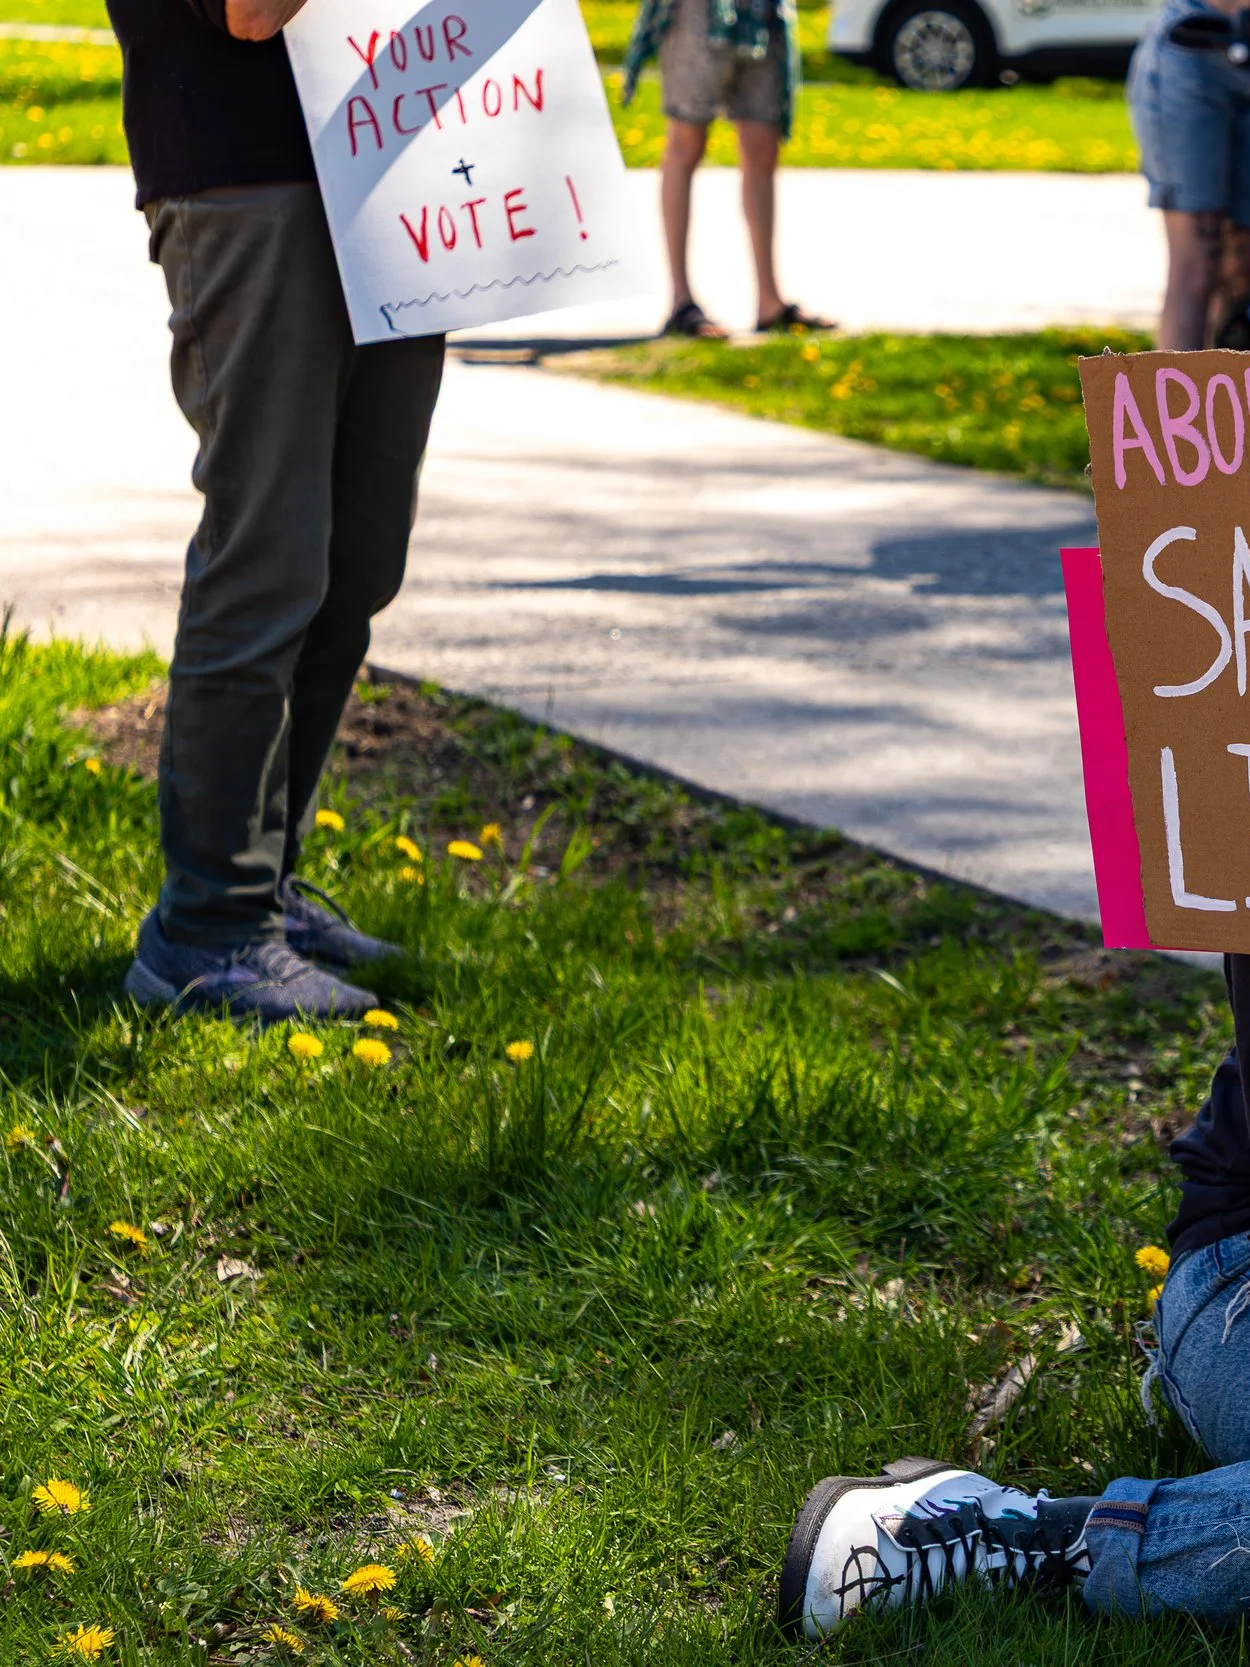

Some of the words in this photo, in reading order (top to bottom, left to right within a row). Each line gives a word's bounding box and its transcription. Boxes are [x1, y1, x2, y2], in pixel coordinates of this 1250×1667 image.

[348, 15, 473, 90] YOUR
[347, 68, 544, 157] ACTION
[400, 187, 537, 264] VOTE
